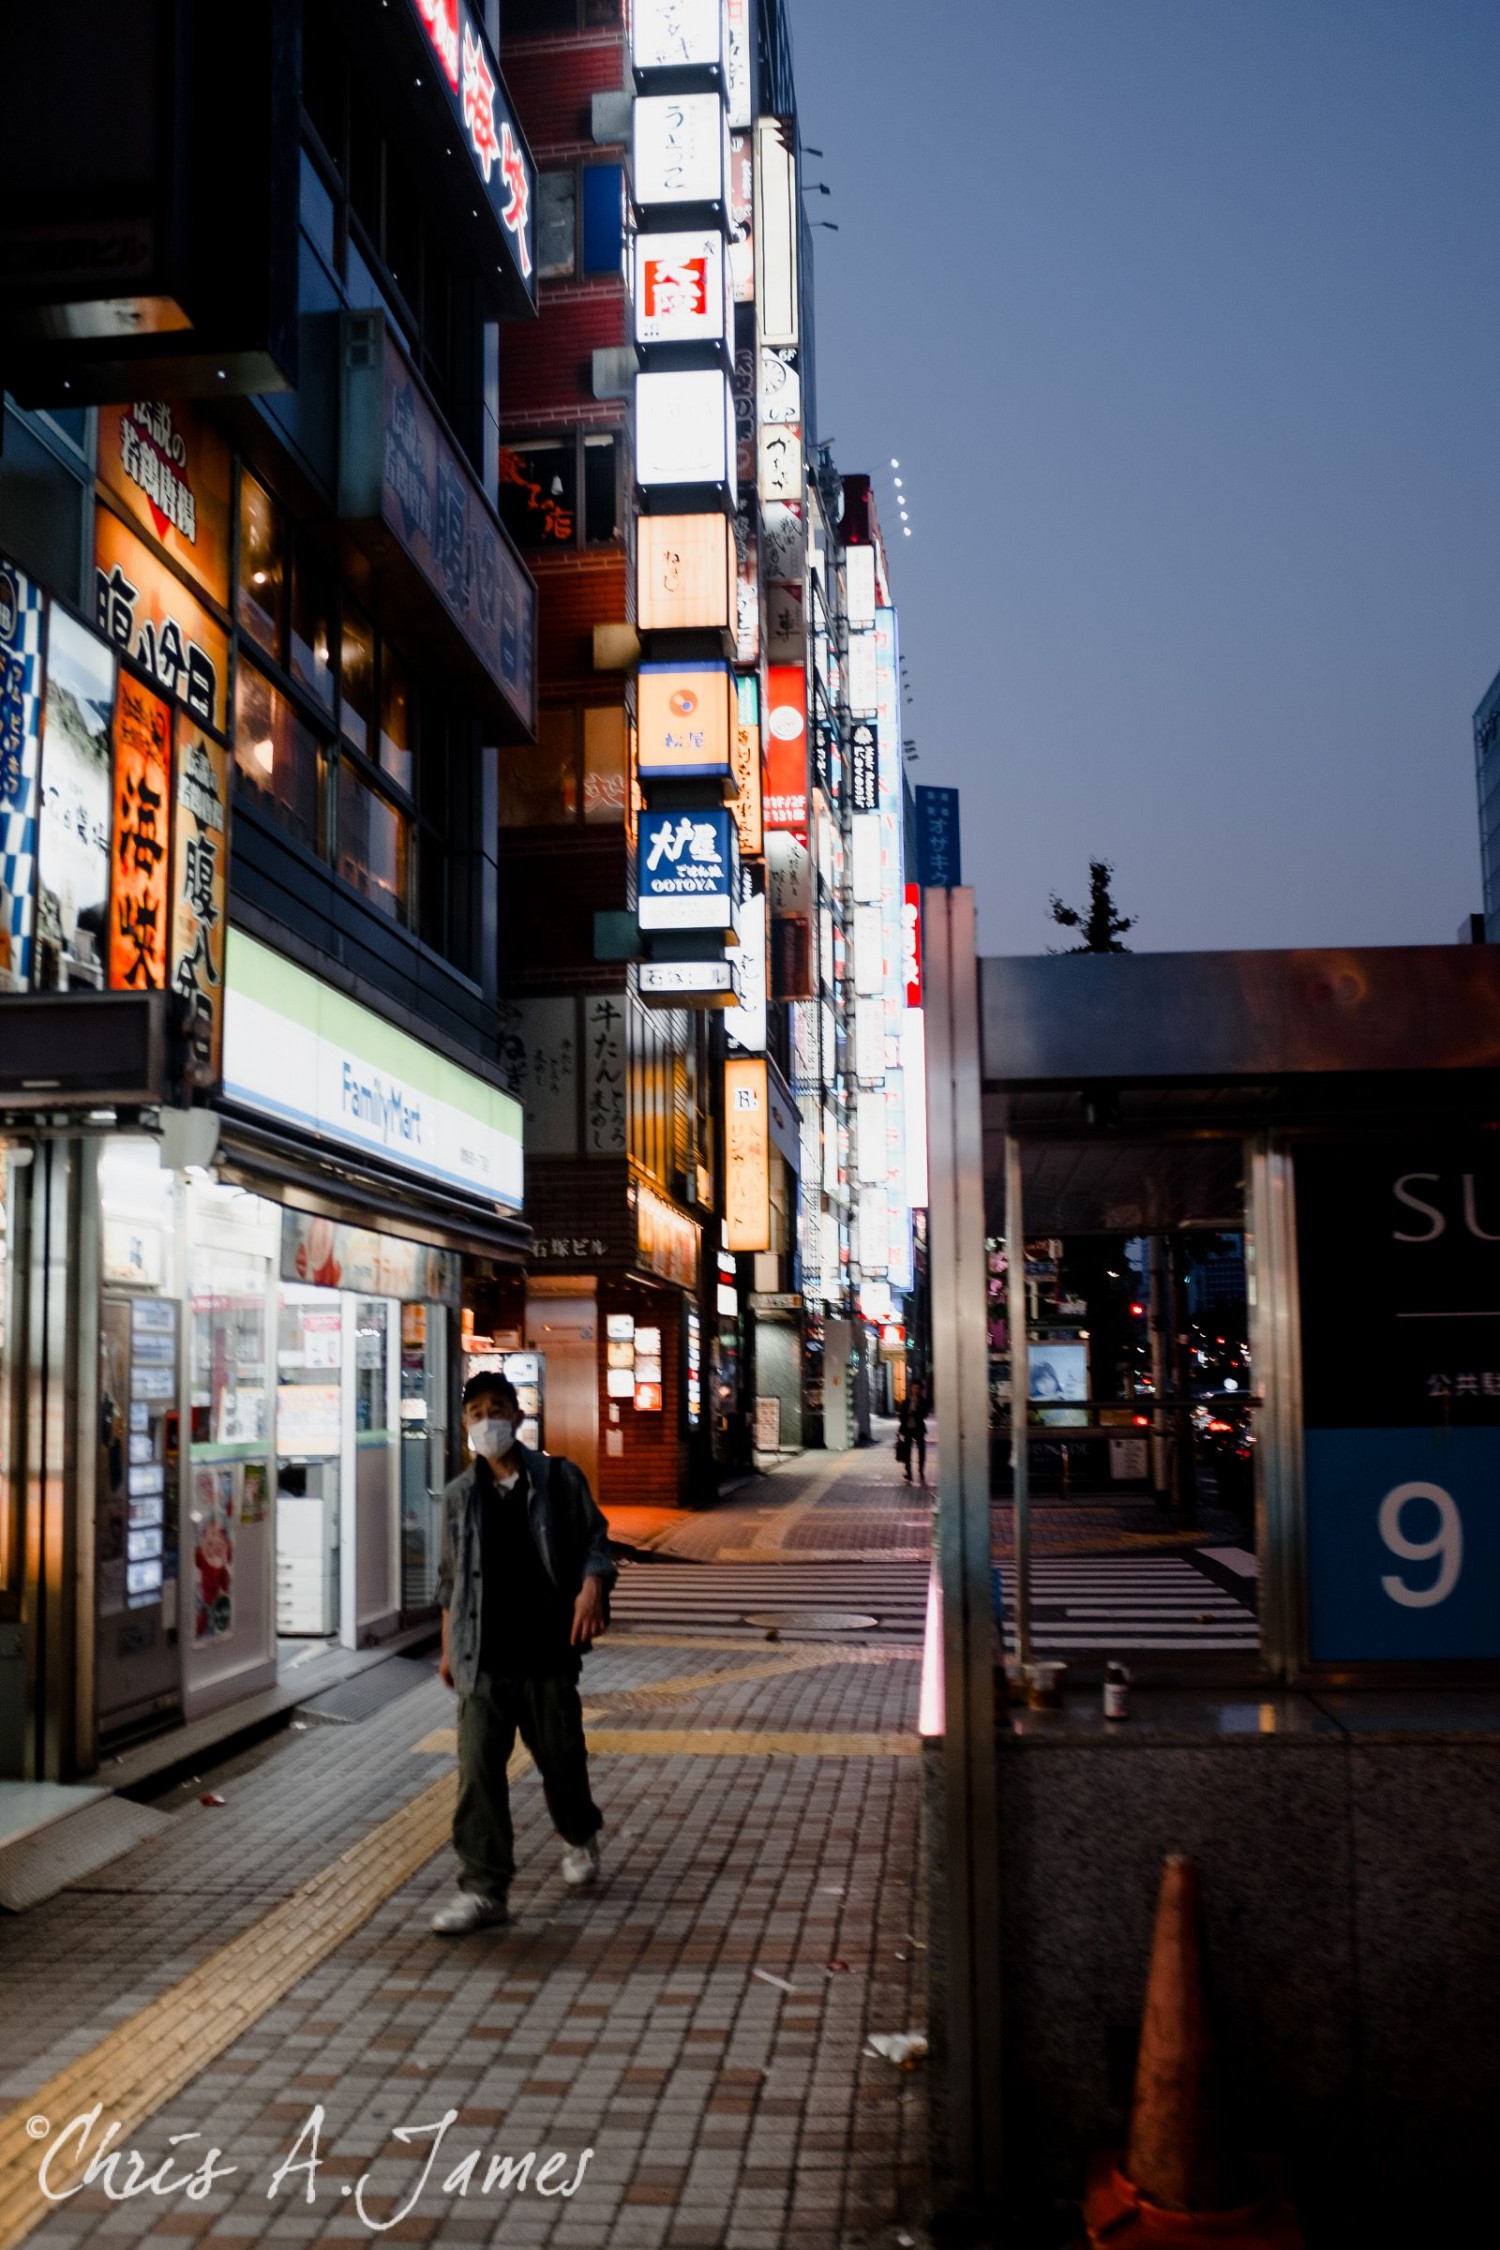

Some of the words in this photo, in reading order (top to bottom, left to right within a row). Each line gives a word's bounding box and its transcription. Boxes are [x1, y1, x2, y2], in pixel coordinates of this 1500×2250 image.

[647, 817, 722, 872] 大戸屋
[651, 878, 718, 893] OOTOYA
[590, 1000, 622, 1084] 牛たん
[342, 1060, 422, 1144] FamilyMart
[531, 1236, 608, 1258] 石塚ビル
[1377, 1481, 1463, 1609] 9
